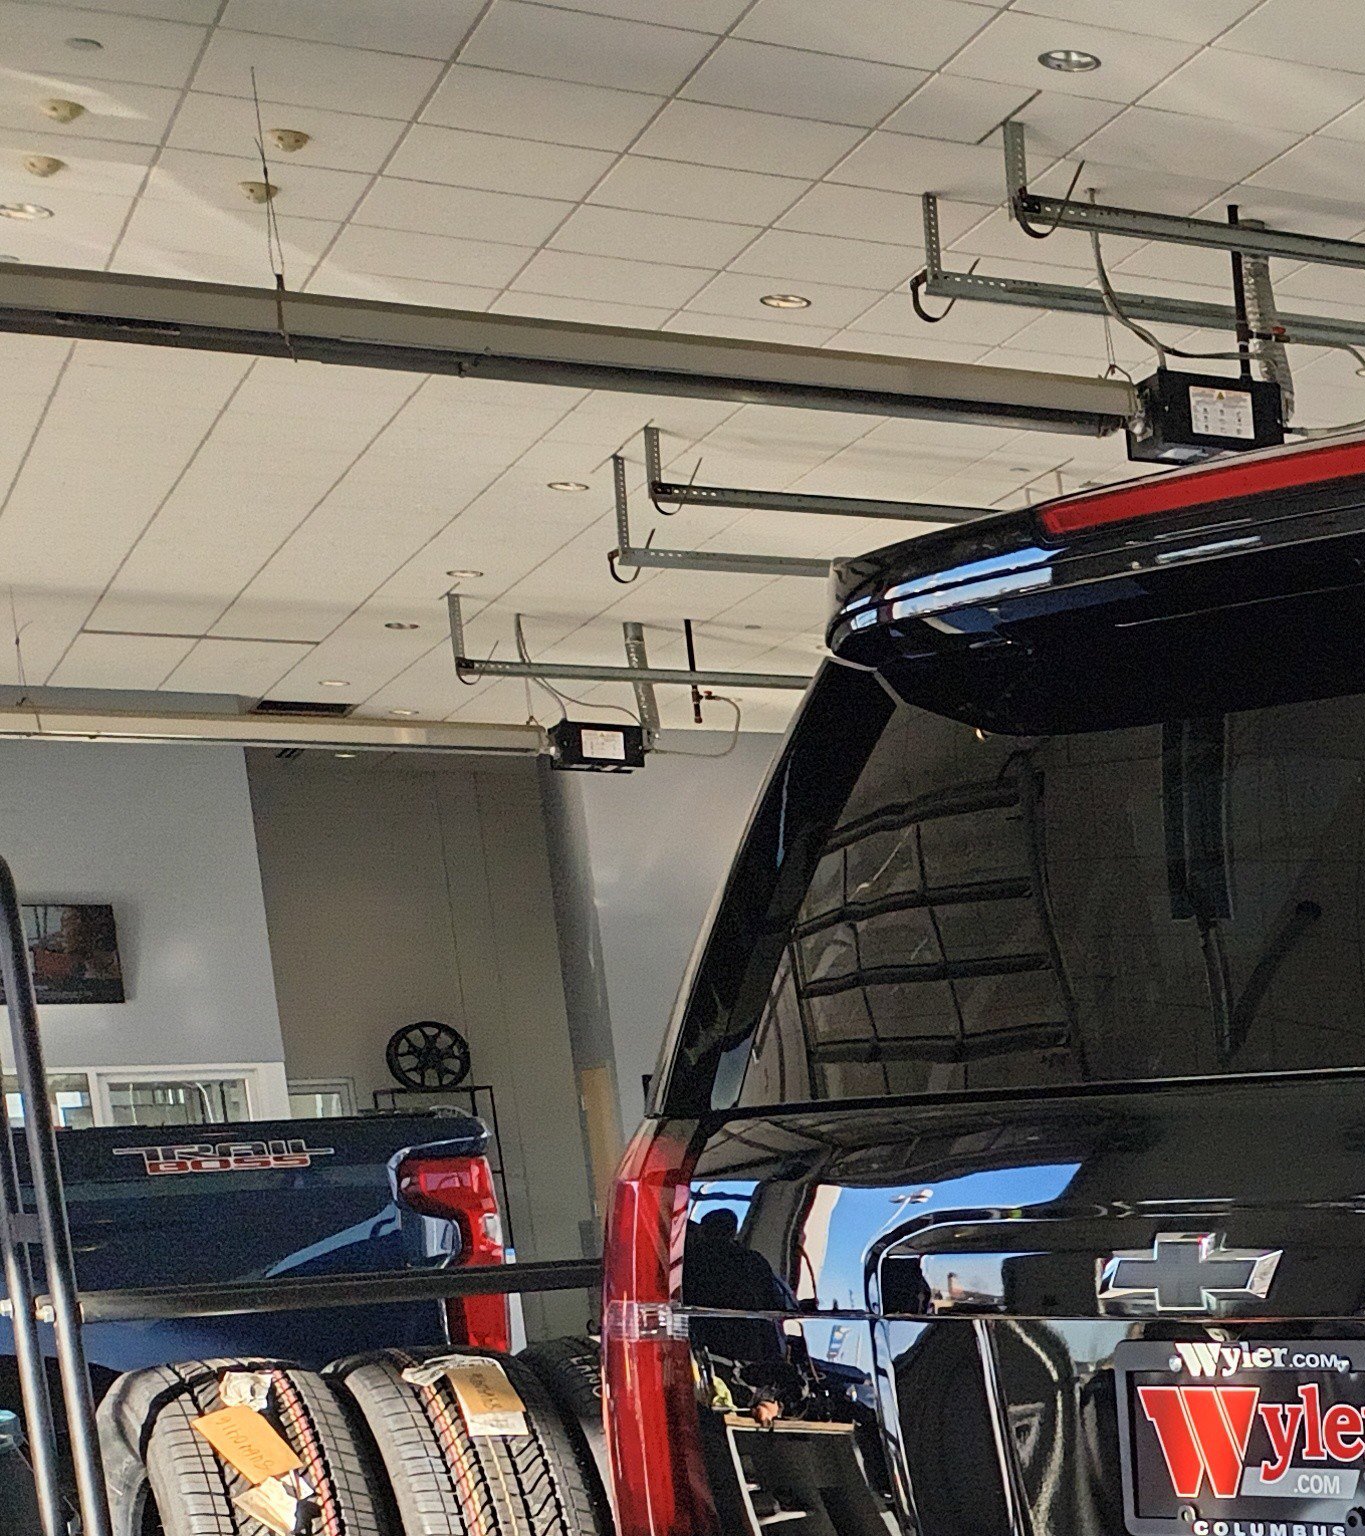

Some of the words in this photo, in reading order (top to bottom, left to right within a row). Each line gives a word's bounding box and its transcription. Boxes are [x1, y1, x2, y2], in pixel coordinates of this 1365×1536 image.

[113, 1139, 334, 1162] TRAIL
[148, 1154, 311, 1175] BOSS
[1293, 1473, 1341, 1495] .COM
